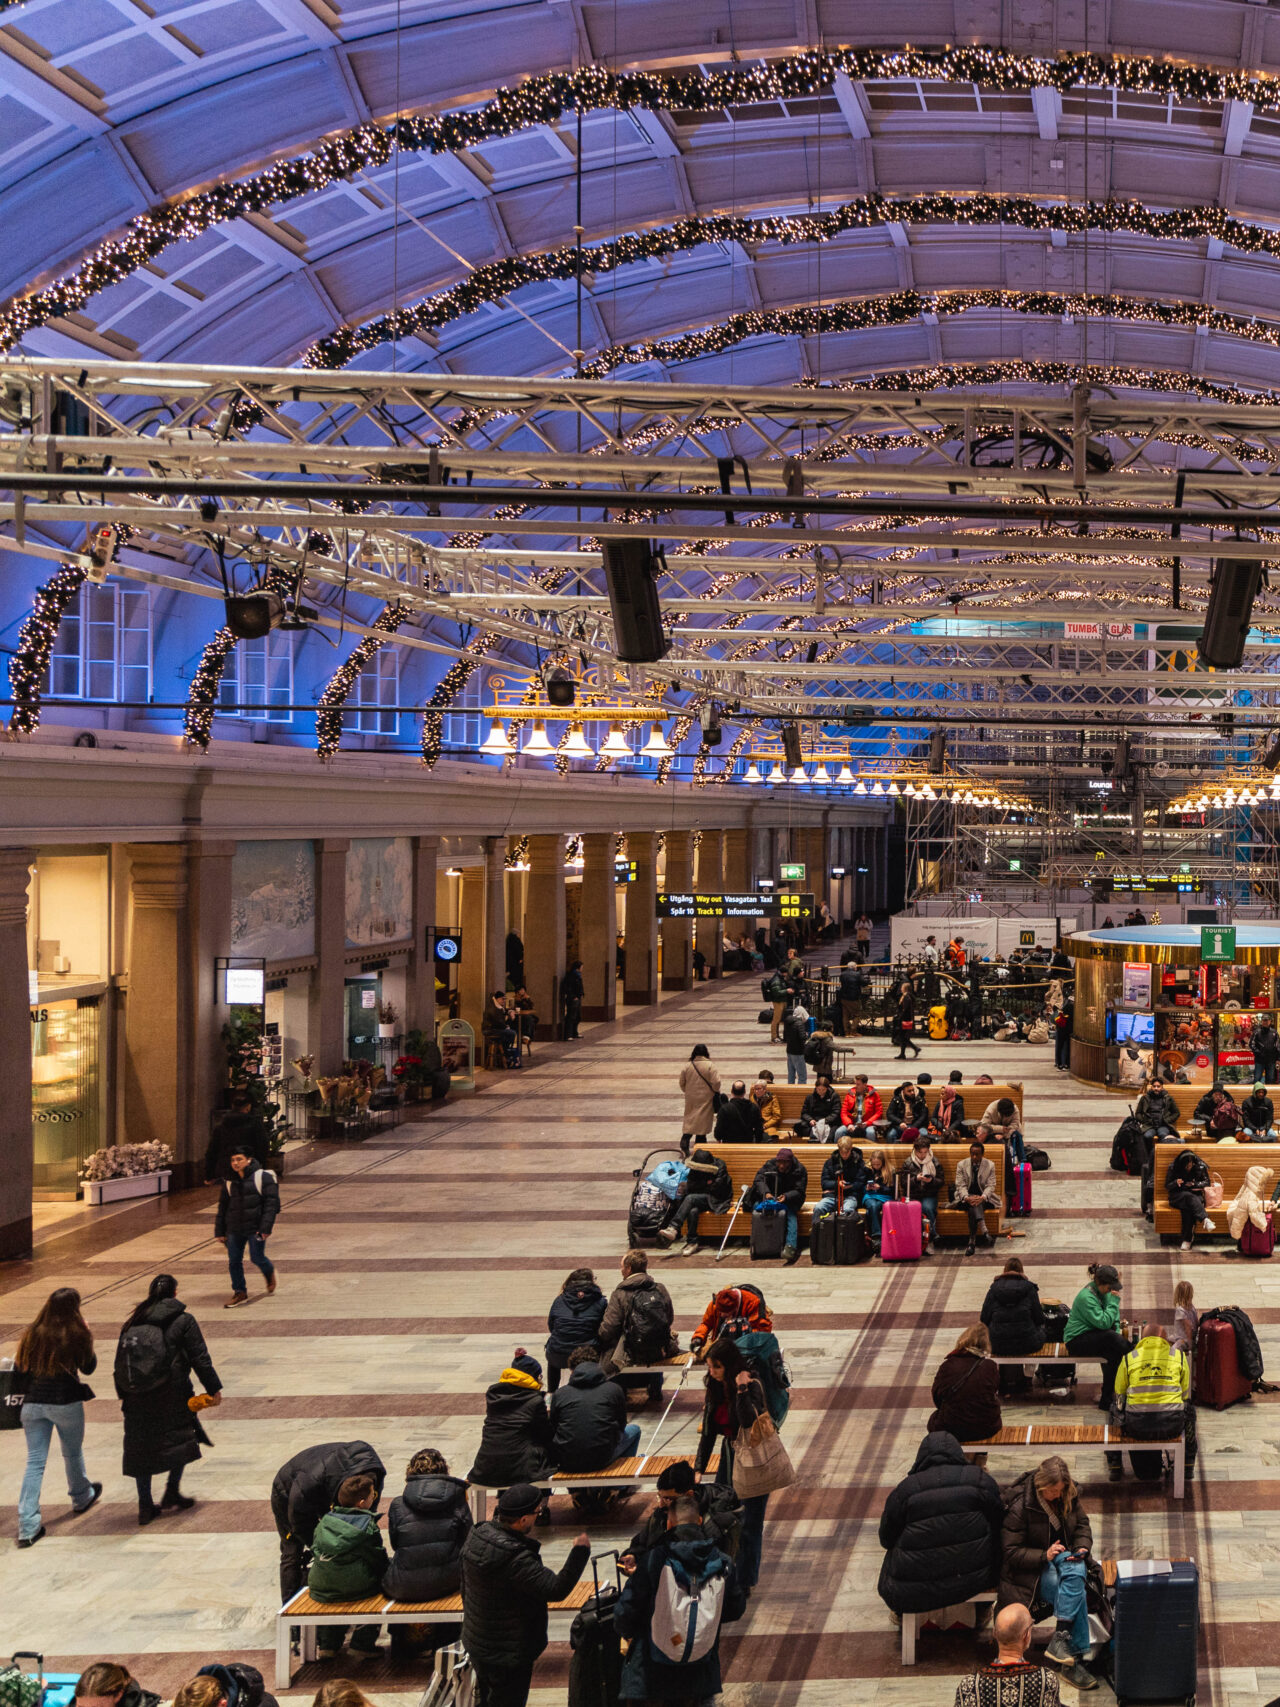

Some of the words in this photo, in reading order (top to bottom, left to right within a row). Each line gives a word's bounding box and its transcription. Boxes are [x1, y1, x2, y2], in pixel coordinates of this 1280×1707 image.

[1068, 624, 1098, 633] TUMBA
[1110, 624, 1132, 634] GLAS
[670, 895, 694, 905] Utgång
[696, 896, 710, 905] Way
[724, 896, 757, 905] Vasagatan
[670, 908, 685, 917] Spår
[5, 1394, 25, 1406] 157
